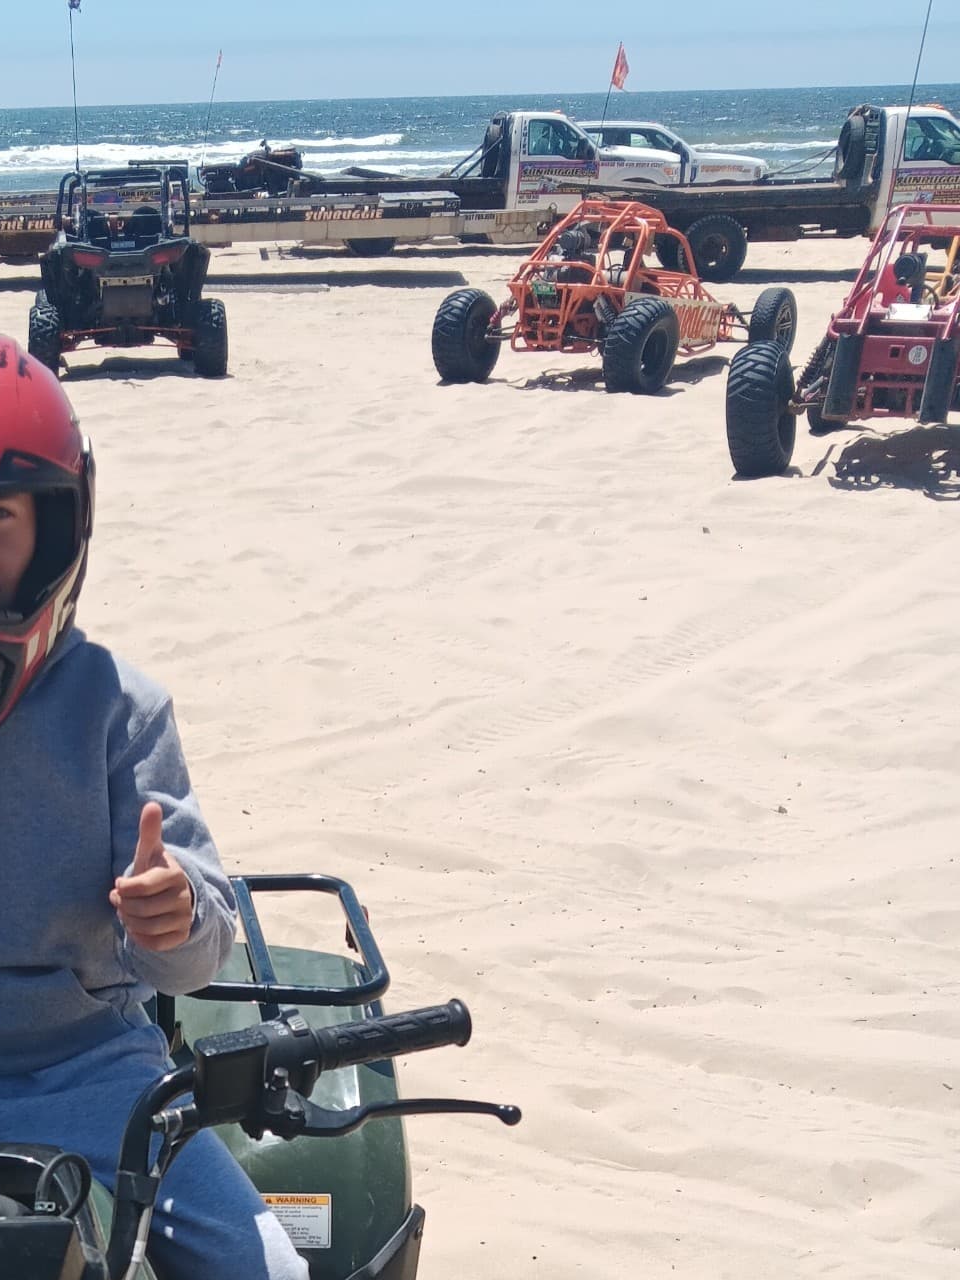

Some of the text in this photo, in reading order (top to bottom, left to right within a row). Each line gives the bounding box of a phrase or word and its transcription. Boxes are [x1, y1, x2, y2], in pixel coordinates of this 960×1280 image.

[304, 208, 384, 221] SUNBUGGIE
[0, 220, 23, 231] THE
[27, 219, 55, 230] FUN
[275, 1196, 317, 1204] WARNING
